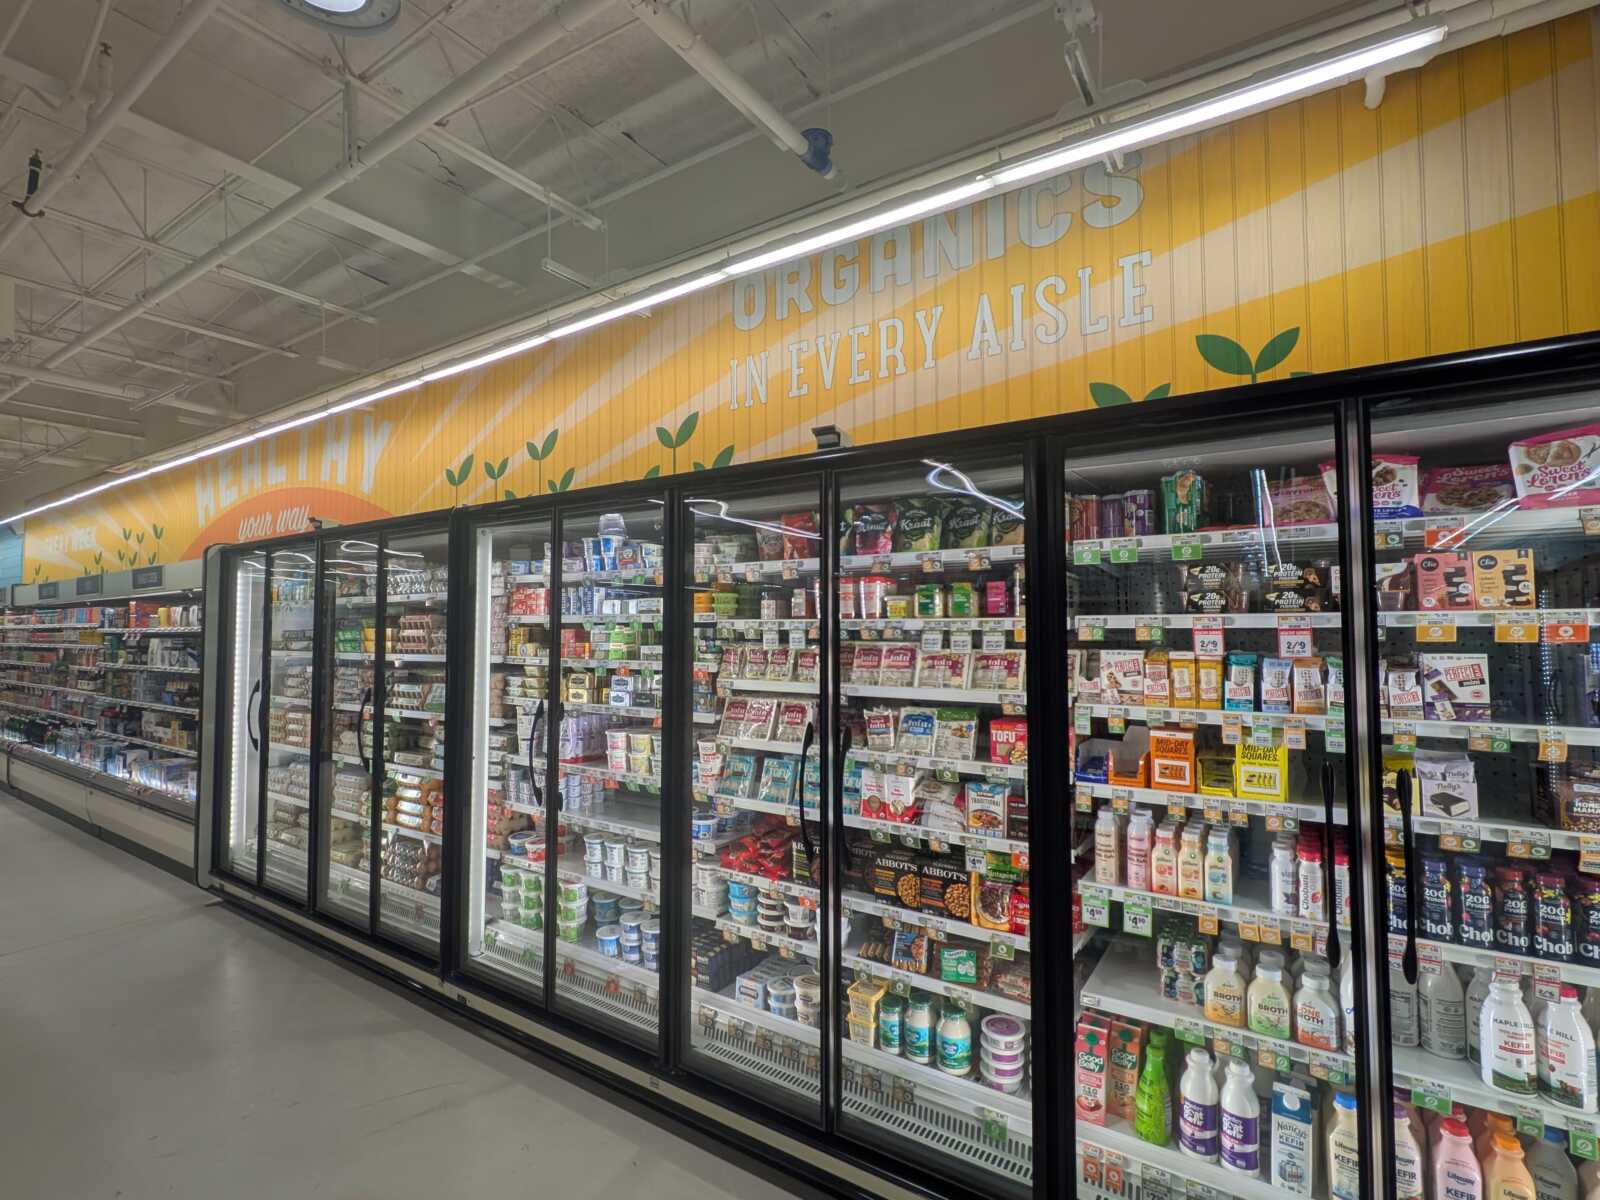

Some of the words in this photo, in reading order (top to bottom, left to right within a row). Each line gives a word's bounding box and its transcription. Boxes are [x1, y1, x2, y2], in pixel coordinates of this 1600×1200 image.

[731, 151, 1145, 332] ORGANICS
[730, 351, 769, 411] IN
[789, 304, 944, 398] EVERY
[967, 249, 1154, 361] AISLE
[1275, 598, 1305, 606] PROTEIN
[992, 730, 1016, 742] TOFU
[1241, 752, 1279, 762] SQUARES
[875, 857, 918, 872] ABBOT'S
[922, 865, 968, 882] ABBOT'S
